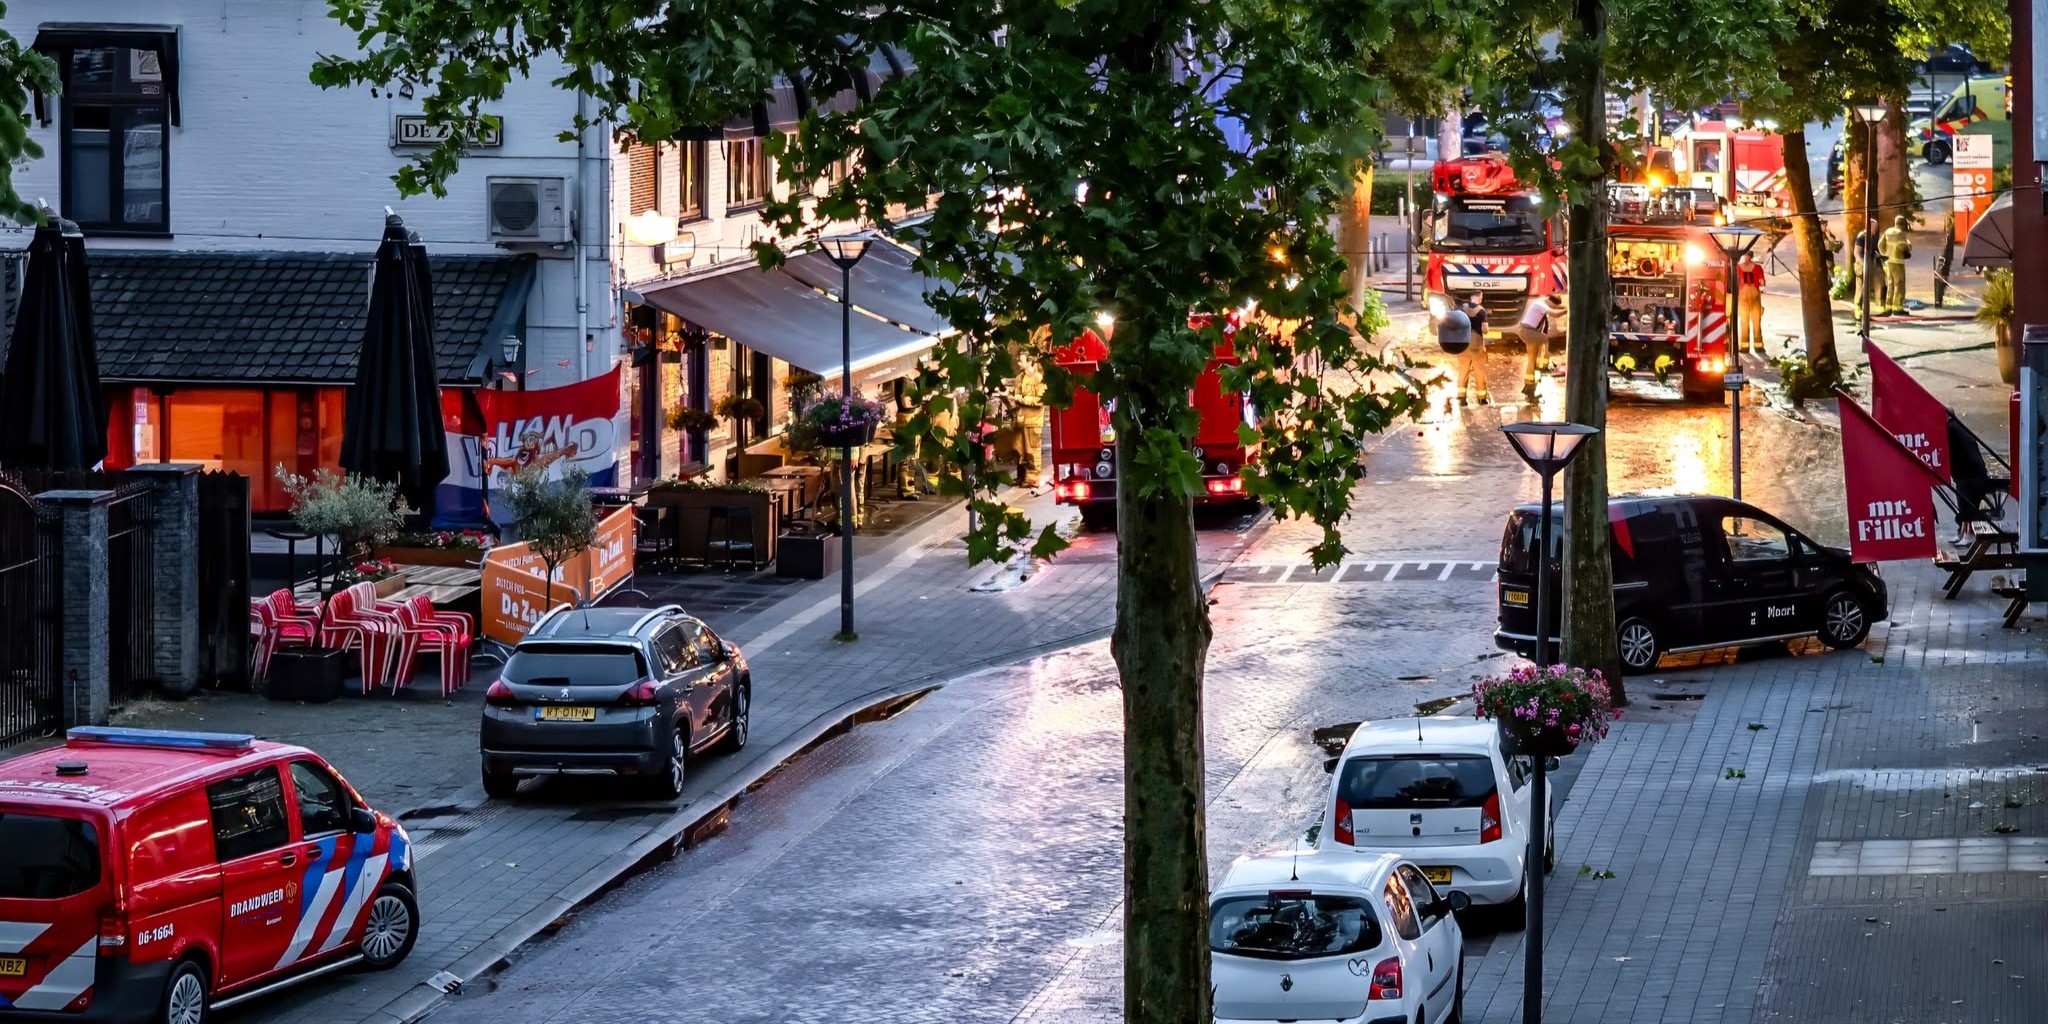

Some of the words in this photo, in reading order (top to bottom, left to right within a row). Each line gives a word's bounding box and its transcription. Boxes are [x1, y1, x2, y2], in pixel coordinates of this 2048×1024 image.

[405, 124, 431, 138] DE
[1868, 500, 1912, 517] mr.
[1858, 517, 1925, 541] Fillet
[502, 593, 519, 619] De
[231, 889, 284, 917] BRANDWEER
[138, 922, 173, 946] 06-1664
